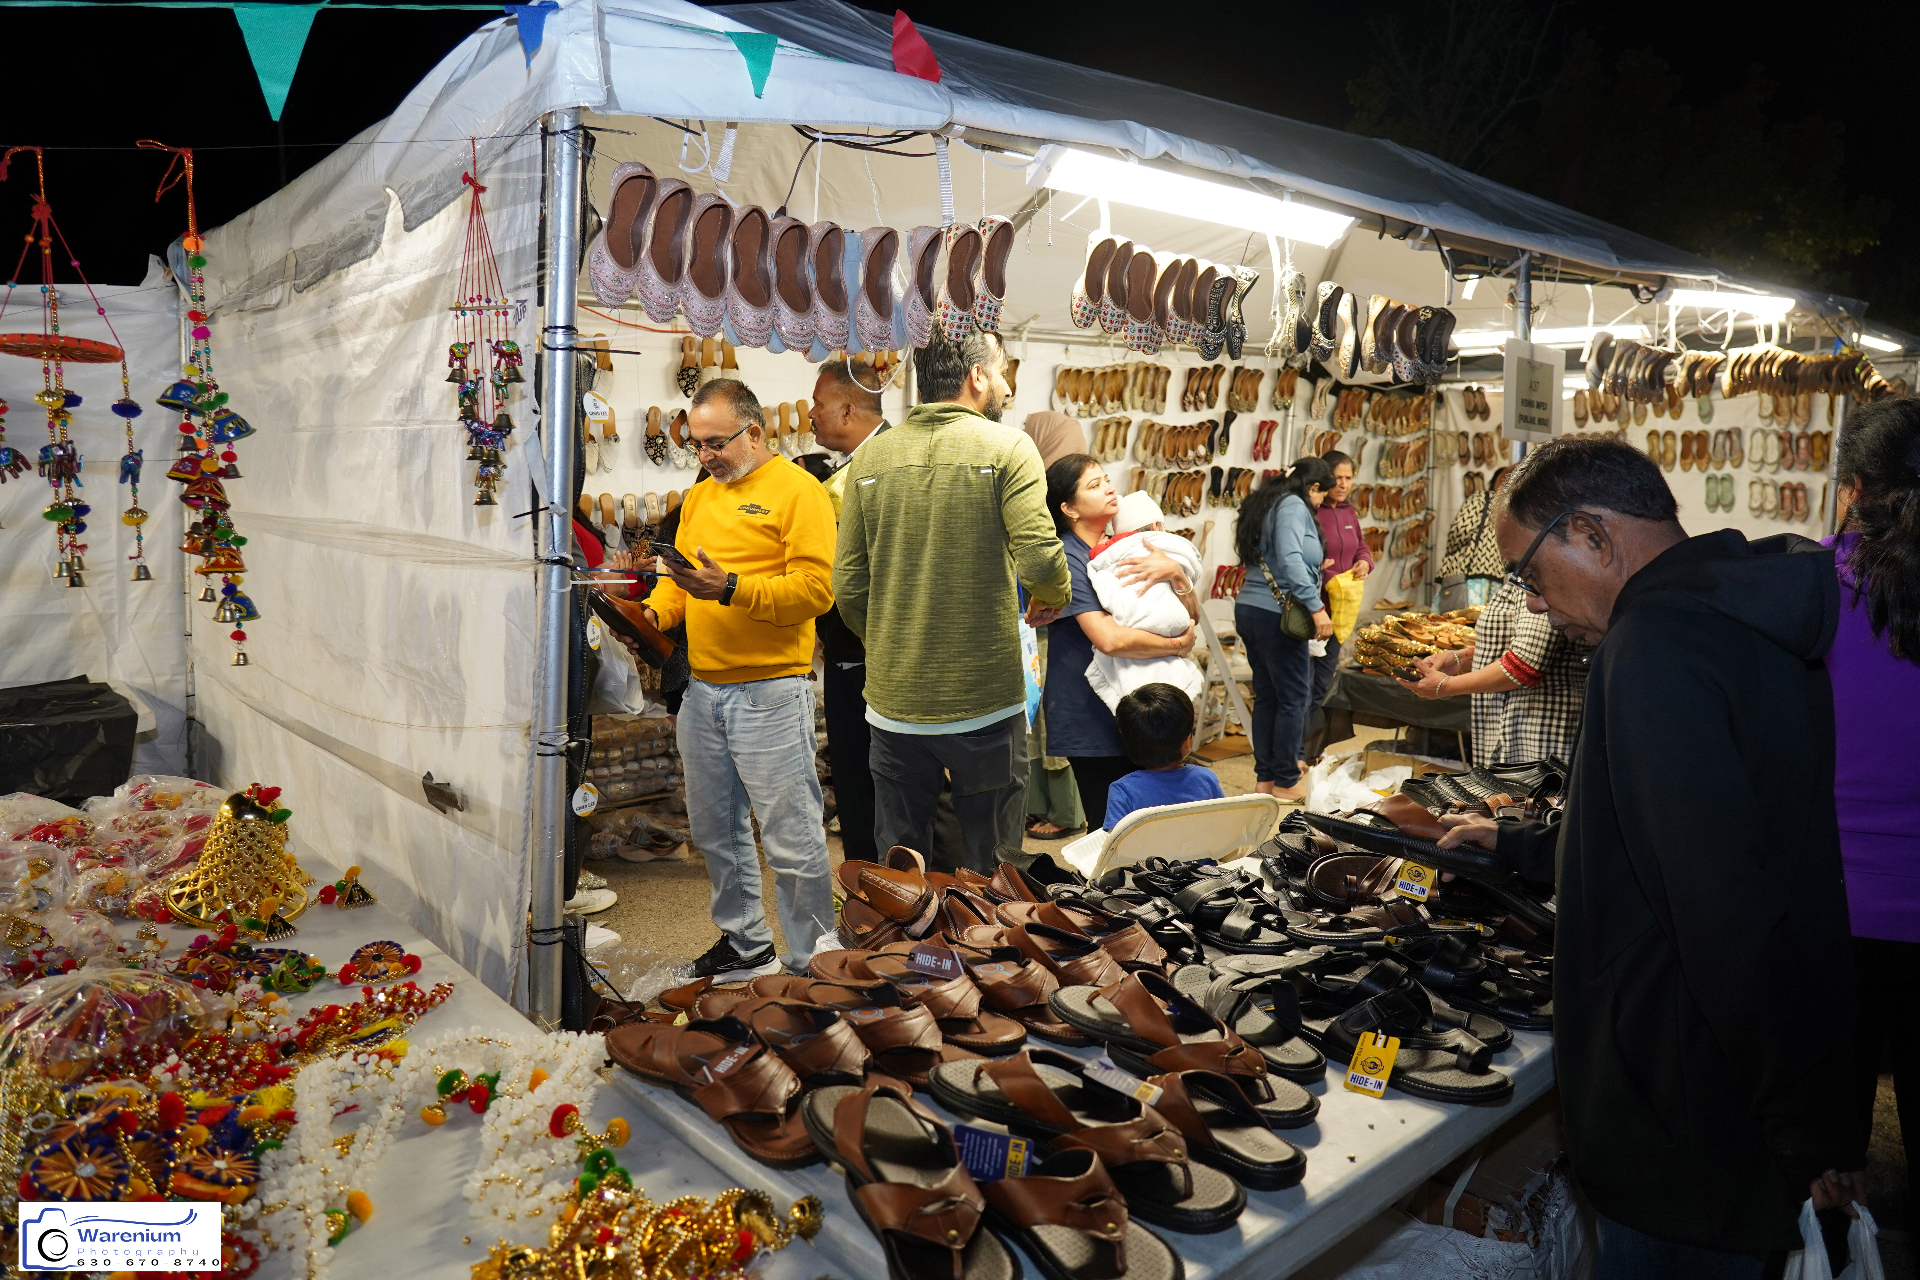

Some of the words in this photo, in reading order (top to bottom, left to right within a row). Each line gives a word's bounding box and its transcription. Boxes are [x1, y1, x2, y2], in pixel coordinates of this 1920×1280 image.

[1398, 880, 1427, 896] HIDE-IN
[915, 952, 953, 971] HIDE-IN
[713, 1045, 750, 1074] HIDE-IN
[1350, 1073, 1384, 1090] HIDE-IN
